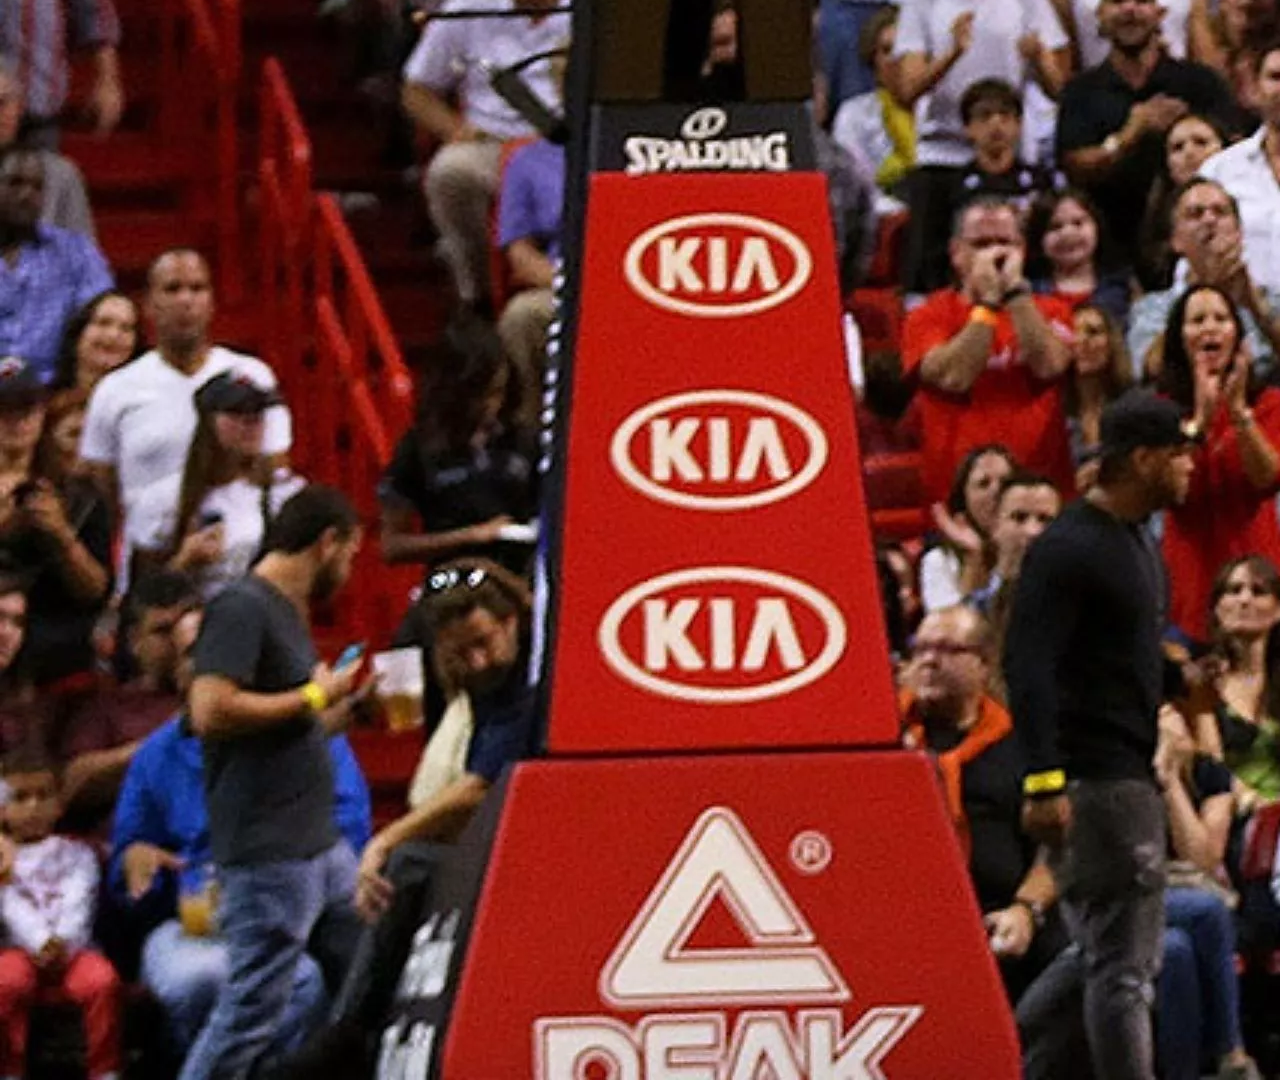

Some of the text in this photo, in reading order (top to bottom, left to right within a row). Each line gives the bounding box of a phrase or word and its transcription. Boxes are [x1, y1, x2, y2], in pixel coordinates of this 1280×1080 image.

[625, 131, 789, 177] SPALDING
[657, 236, 782, 293] KIA
[649, 417, 793, 482] KIA
[643, 598, 807, 672] KIA
[533, 1005, 925, 1080] PEAK
